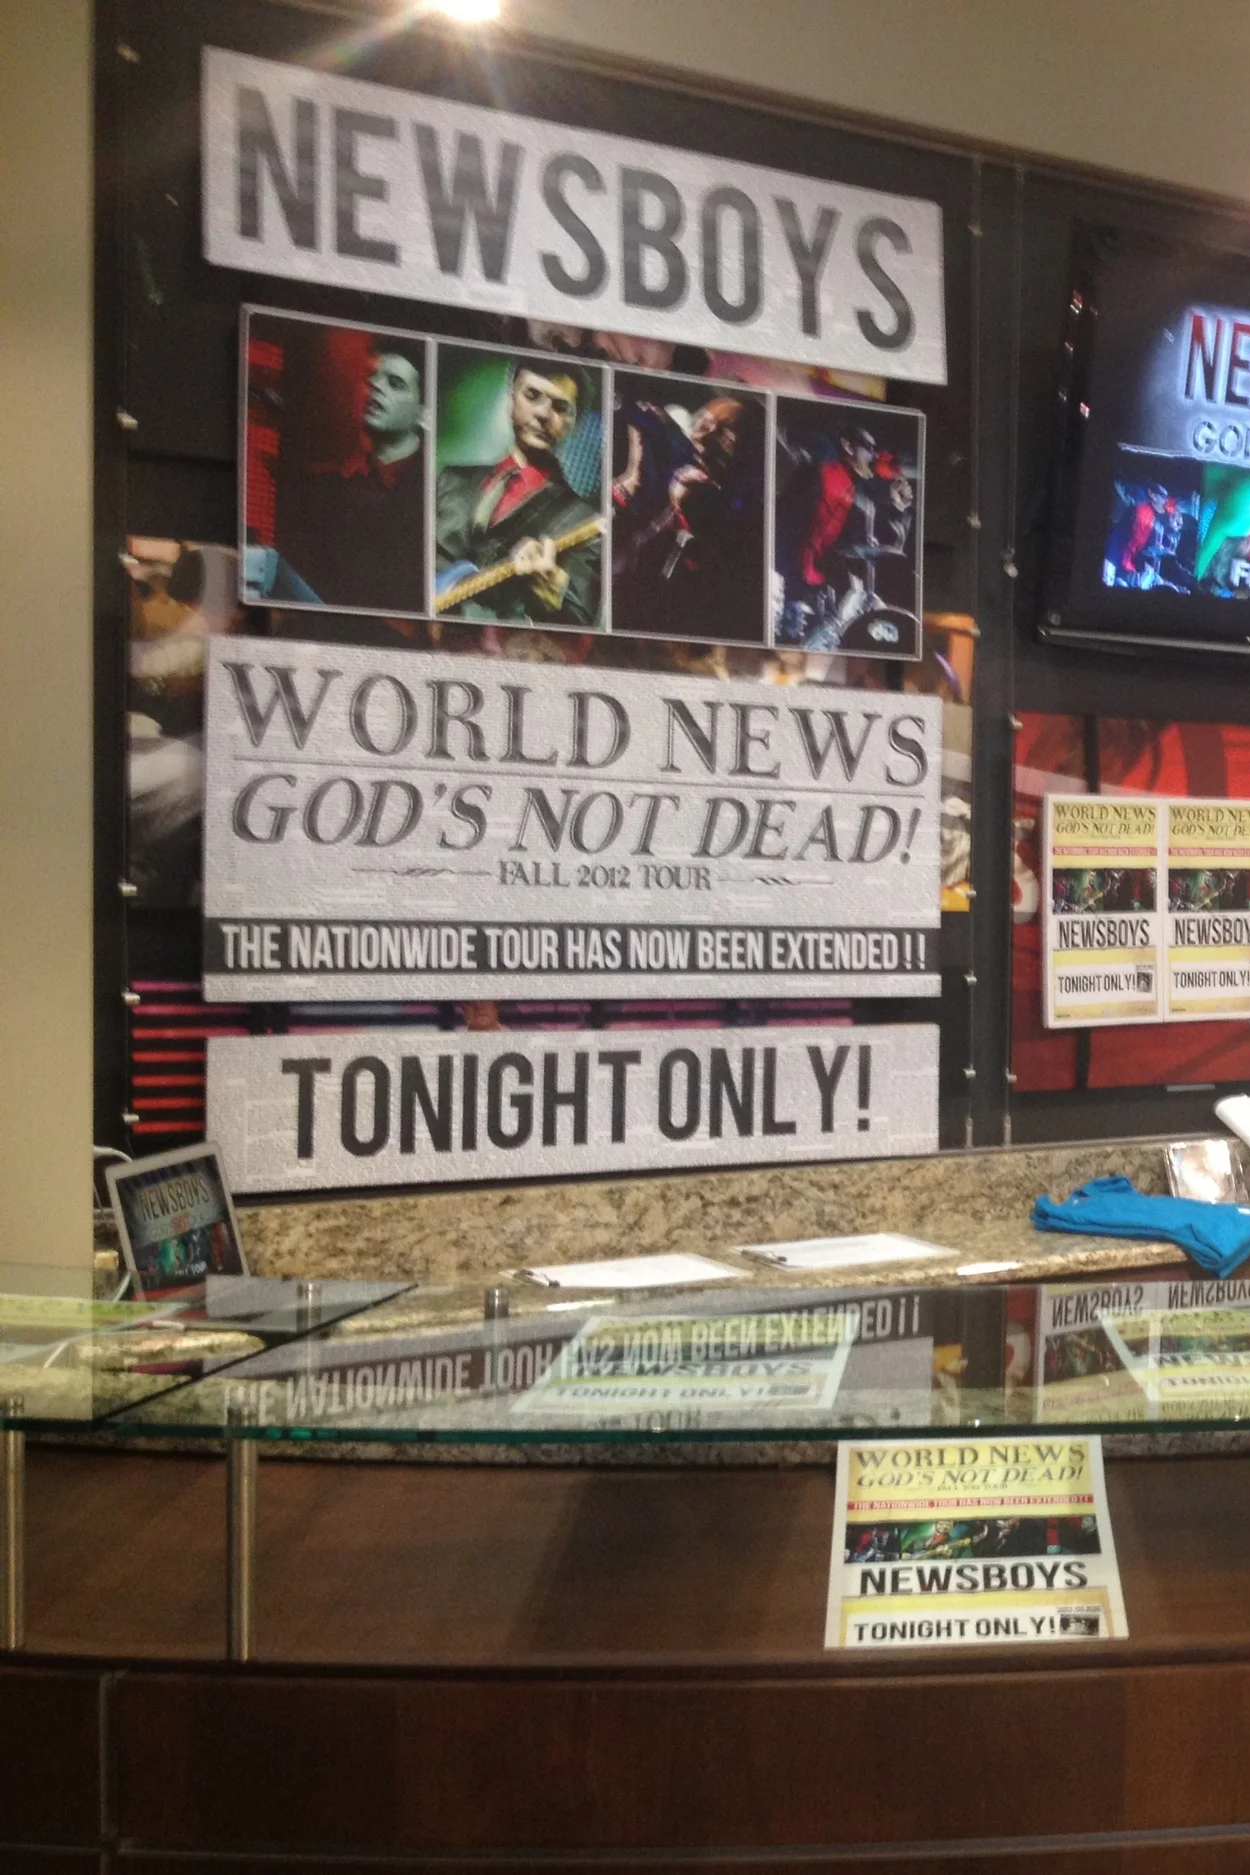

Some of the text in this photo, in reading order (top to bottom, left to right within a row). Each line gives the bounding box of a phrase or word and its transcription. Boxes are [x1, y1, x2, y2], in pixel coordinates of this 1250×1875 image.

[235, 83, 917, 352] NEWSBOYS
[223, 660, 929, 788] WORLD NEWS
[231, 772, 922, 865] GOD'S NOT DEAD!
[1056, 804, 1156, 821] WORLD NEWS
[1172, 807, 1224, 823] WORLD
[1092, 822, 1115, 835] NOT
[1208, 824, 1231, 837] NOT
[498, 859, 713, 891] FALL 2012 TOUR
[221, 923, 280, 970] THE
[288, 924, 479, 971] NATIONWIDE
[484, 927, 561, 971] TOUR
[566, 930, 622, 971] HAS
[629, 931, 691, 971] NOW
[697, 931, 765, 971] BEEN
[1058, 918, 1150, 949] NEWSBOYS
[1057, 974, 1136, 994] TONIGHT ONLY!
[1173, 970, 1250, 989] TONIGHT ONLY!
[281, 1044, 874, 1161] TONIGHT ONLY!
[140, 1176, 210, 1222] NEWSBOYS
[856, 1443, 1086, 1470] WORLD NEWS
[857, 1465, 1083, 1488] GOD'S NOT DEAD!
[860, 1561, 1088, 1596] NEWSBOYS
[853, 1616, 1056, 1641] TONIGHT ONLY!
